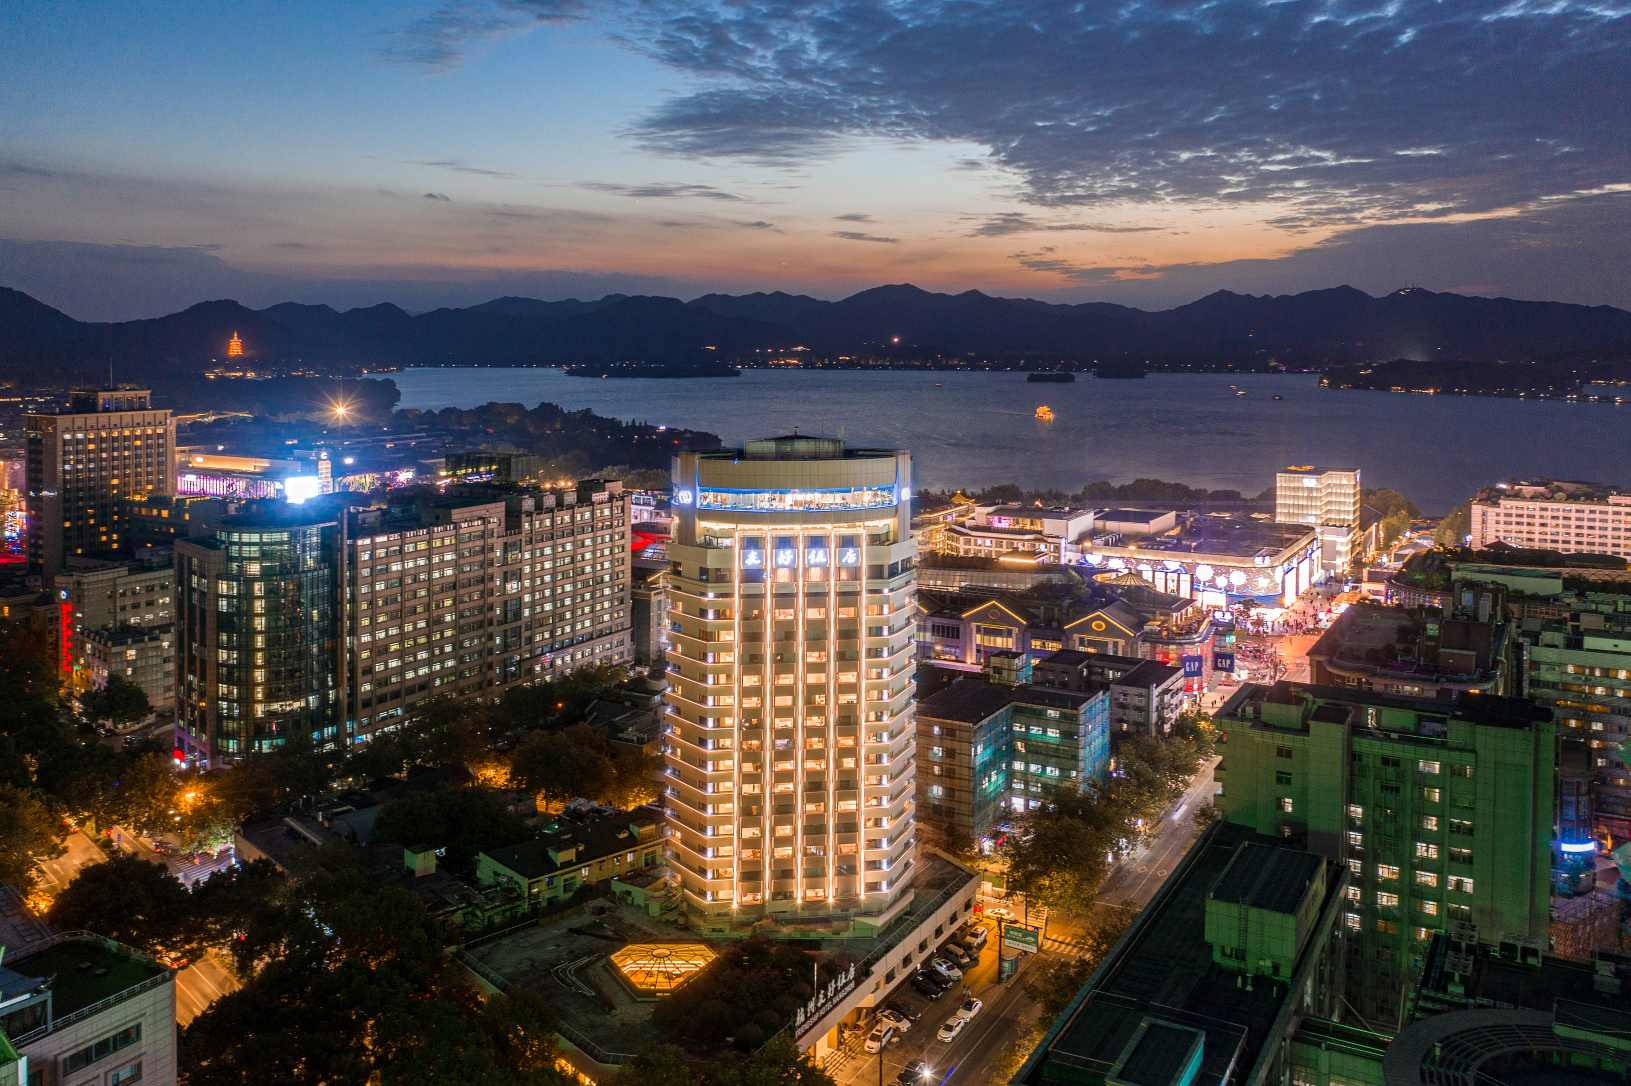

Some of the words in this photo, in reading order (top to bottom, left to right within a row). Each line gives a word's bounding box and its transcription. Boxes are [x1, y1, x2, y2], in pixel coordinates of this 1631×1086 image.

[1185, 661, 1199, 672] GAP
[1217, 658, 1231, 668] GAP
[795, 1012, 820, 1039] FRIENDSHIP
[819, 999, 833, 1017] HOTEL
[832, 980, 855, 1006] HANGZHOU
